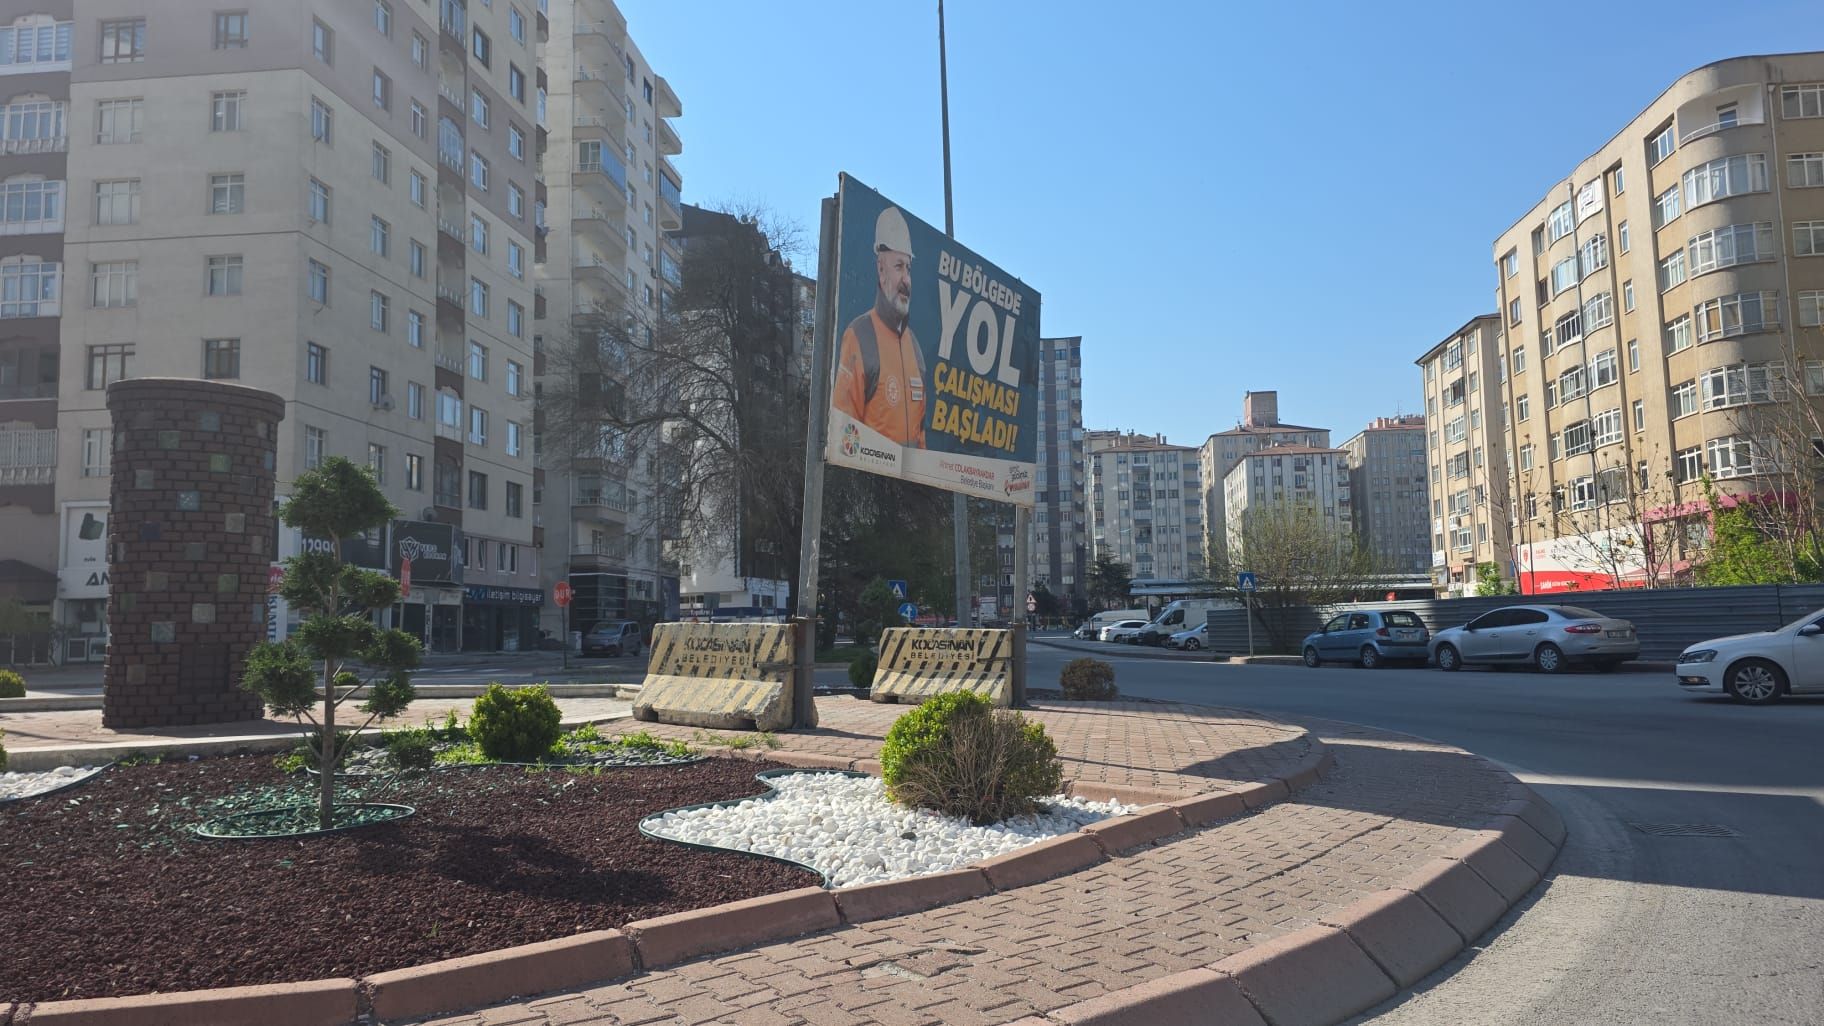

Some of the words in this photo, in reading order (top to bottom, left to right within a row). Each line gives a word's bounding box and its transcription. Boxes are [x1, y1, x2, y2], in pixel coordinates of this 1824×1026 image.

[939, 250, 961, 282] BU
[962, 263, 1022, 316] BÖLGEDE
[938, 279, 1020, 388] YOL
[934, 362, 1020, 417] ÇALIŞMASI
[931, 399, 1018, 453] BAŞLADI!
[554, 589, 572, 600] DUR
